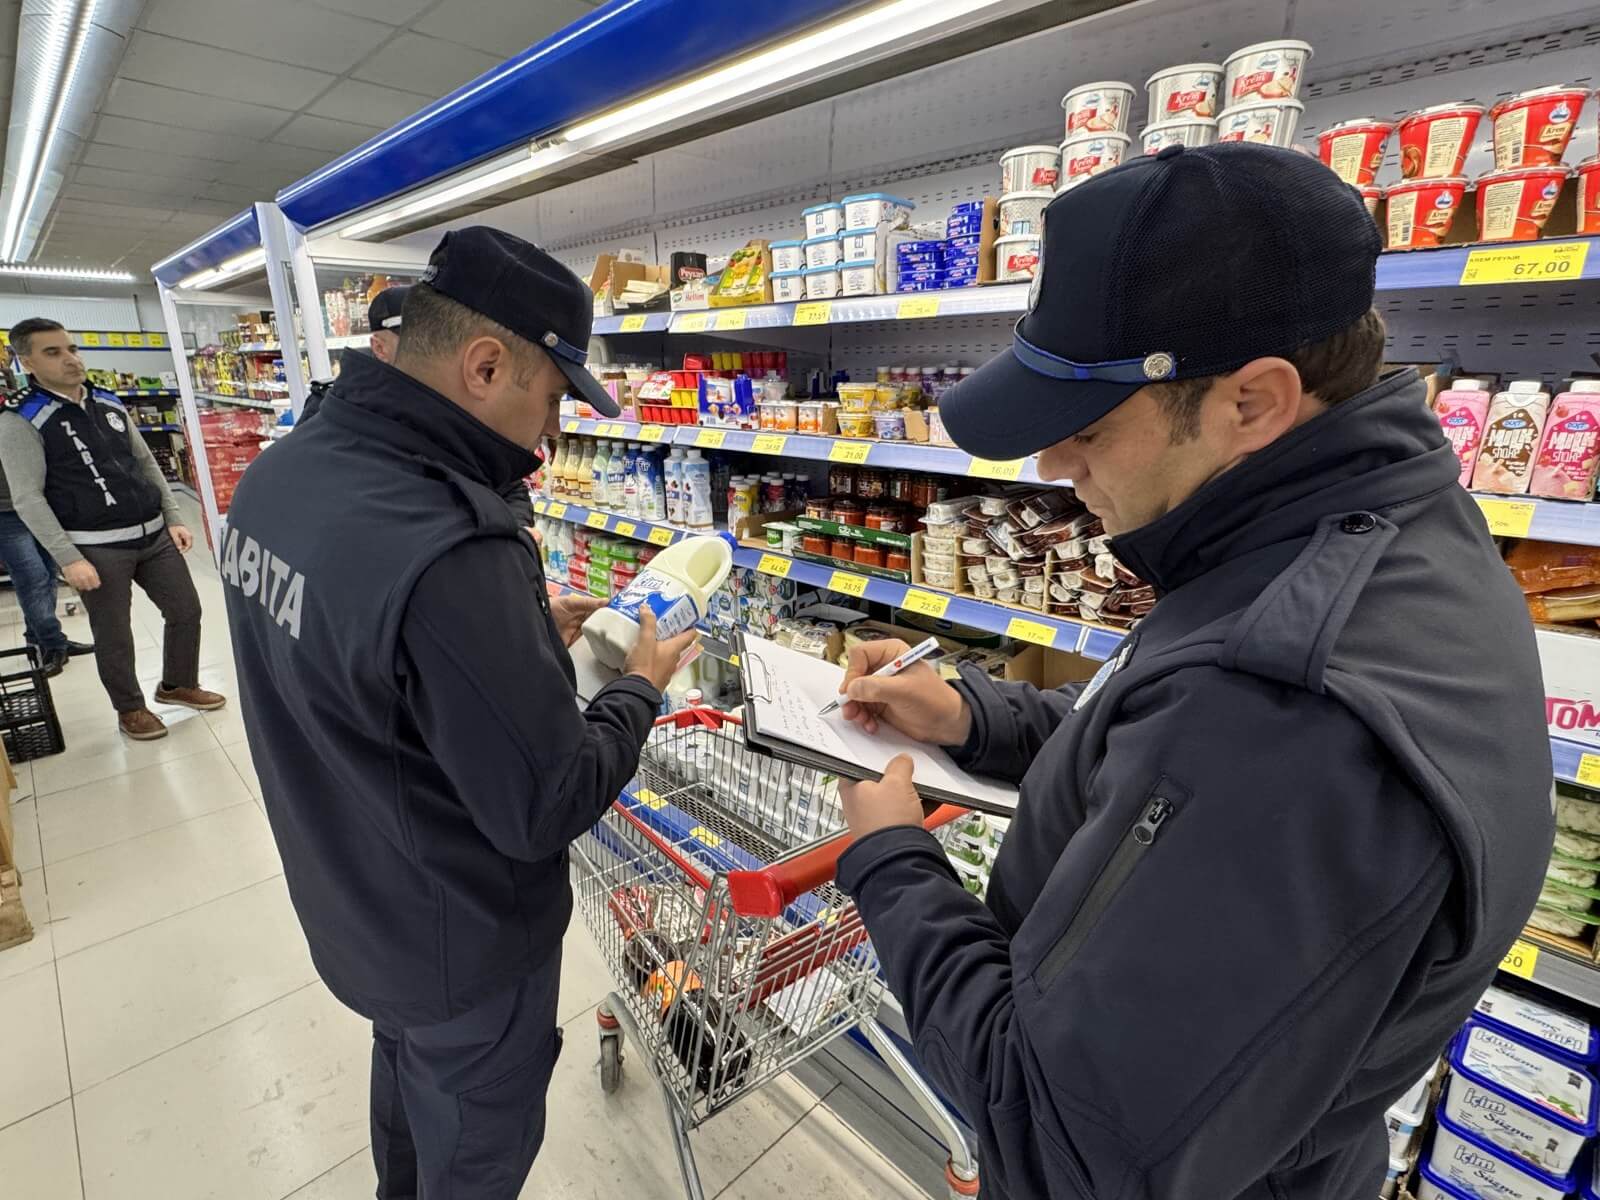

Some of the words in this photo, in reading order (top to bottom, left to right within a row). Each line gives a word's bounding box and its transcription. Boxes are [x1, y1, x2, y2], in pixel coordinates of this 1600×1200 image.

[1513, 260, 1571, 276] 67,00
[60, 420, 117, 507] ZABITA
[222, 527, 305, 640] ABITA
[1483, 1111, 1535, 1142] Süzme
[1473, 1169, 1523, 1199] Süzme
